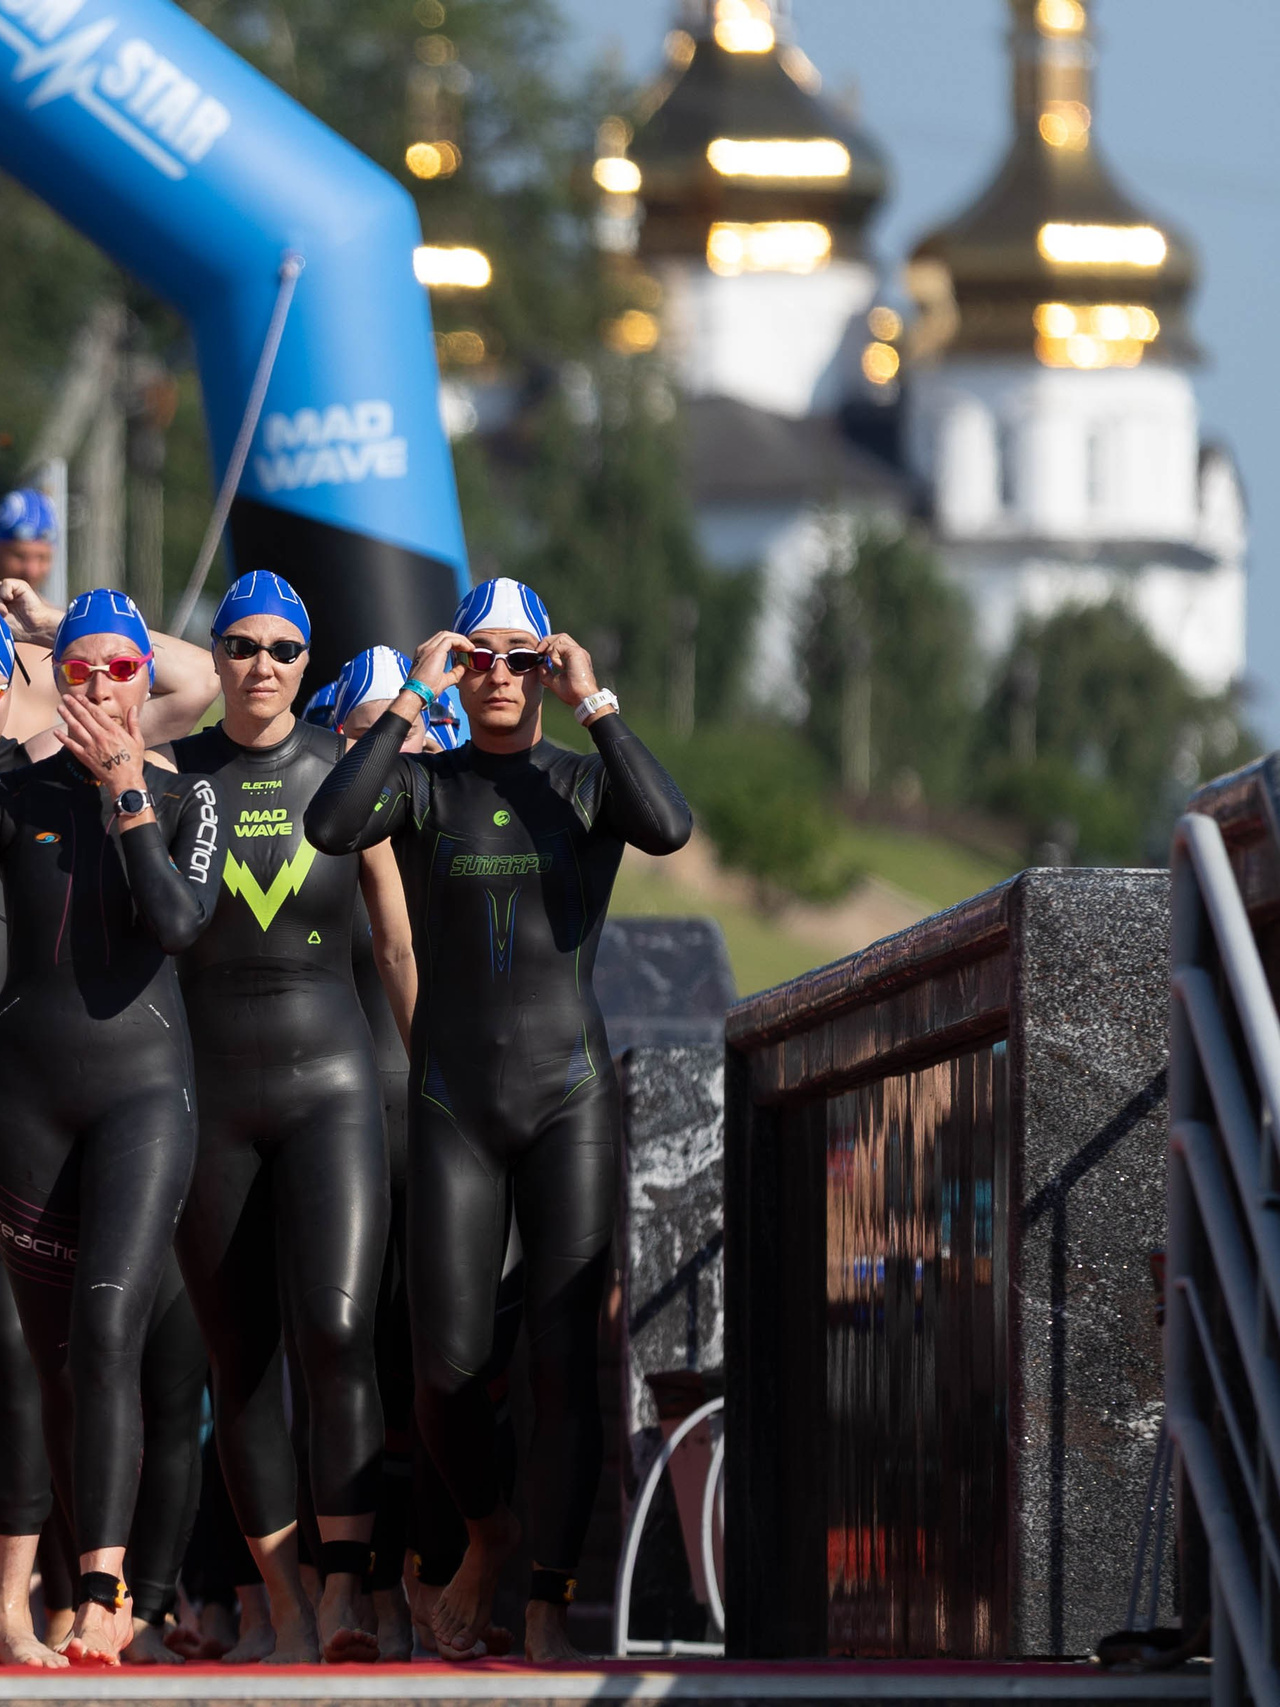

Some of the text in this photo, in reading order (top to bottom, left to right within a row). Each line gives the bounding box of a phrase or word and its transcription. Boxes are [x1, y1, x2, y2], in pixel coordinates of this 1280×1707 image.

[100, 38, 231, 163] STAR
[263, 400, 394, 450] MAD
[253, 436, 408, 492] WAVE
[241, 780, 283, 790] ELECTRA
[188, 779, 219, 884] reaction
[234, 822, 293, 837] WAVE
[239, 808, 288, 823] MAD
[450, 852, 553, 876] SUMARPO
